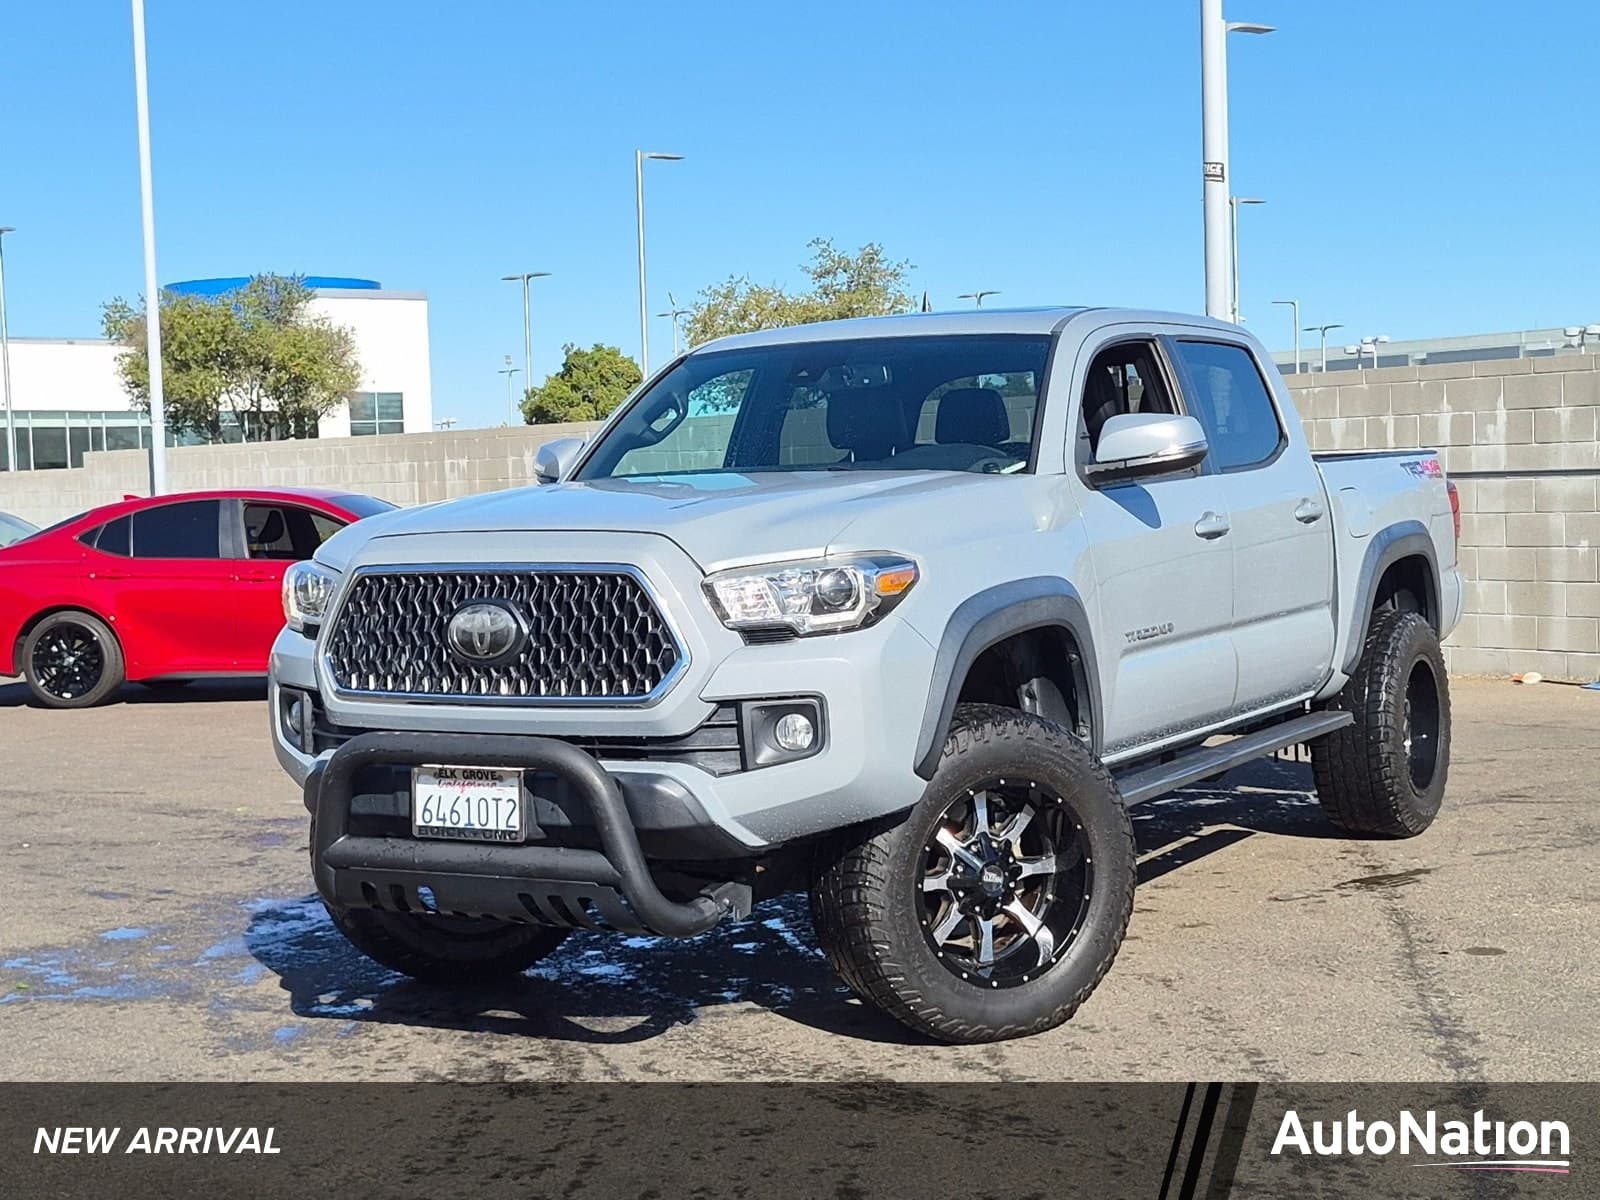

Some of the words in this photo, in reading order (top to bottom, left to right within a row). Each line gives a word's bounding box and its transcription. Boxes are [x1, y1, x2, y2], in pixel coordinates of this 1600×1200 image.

[440, 769, 457, 779] ELK
[462, 770, 497, 780] GROVE
[421, 794, 517, 829] 64610T2
